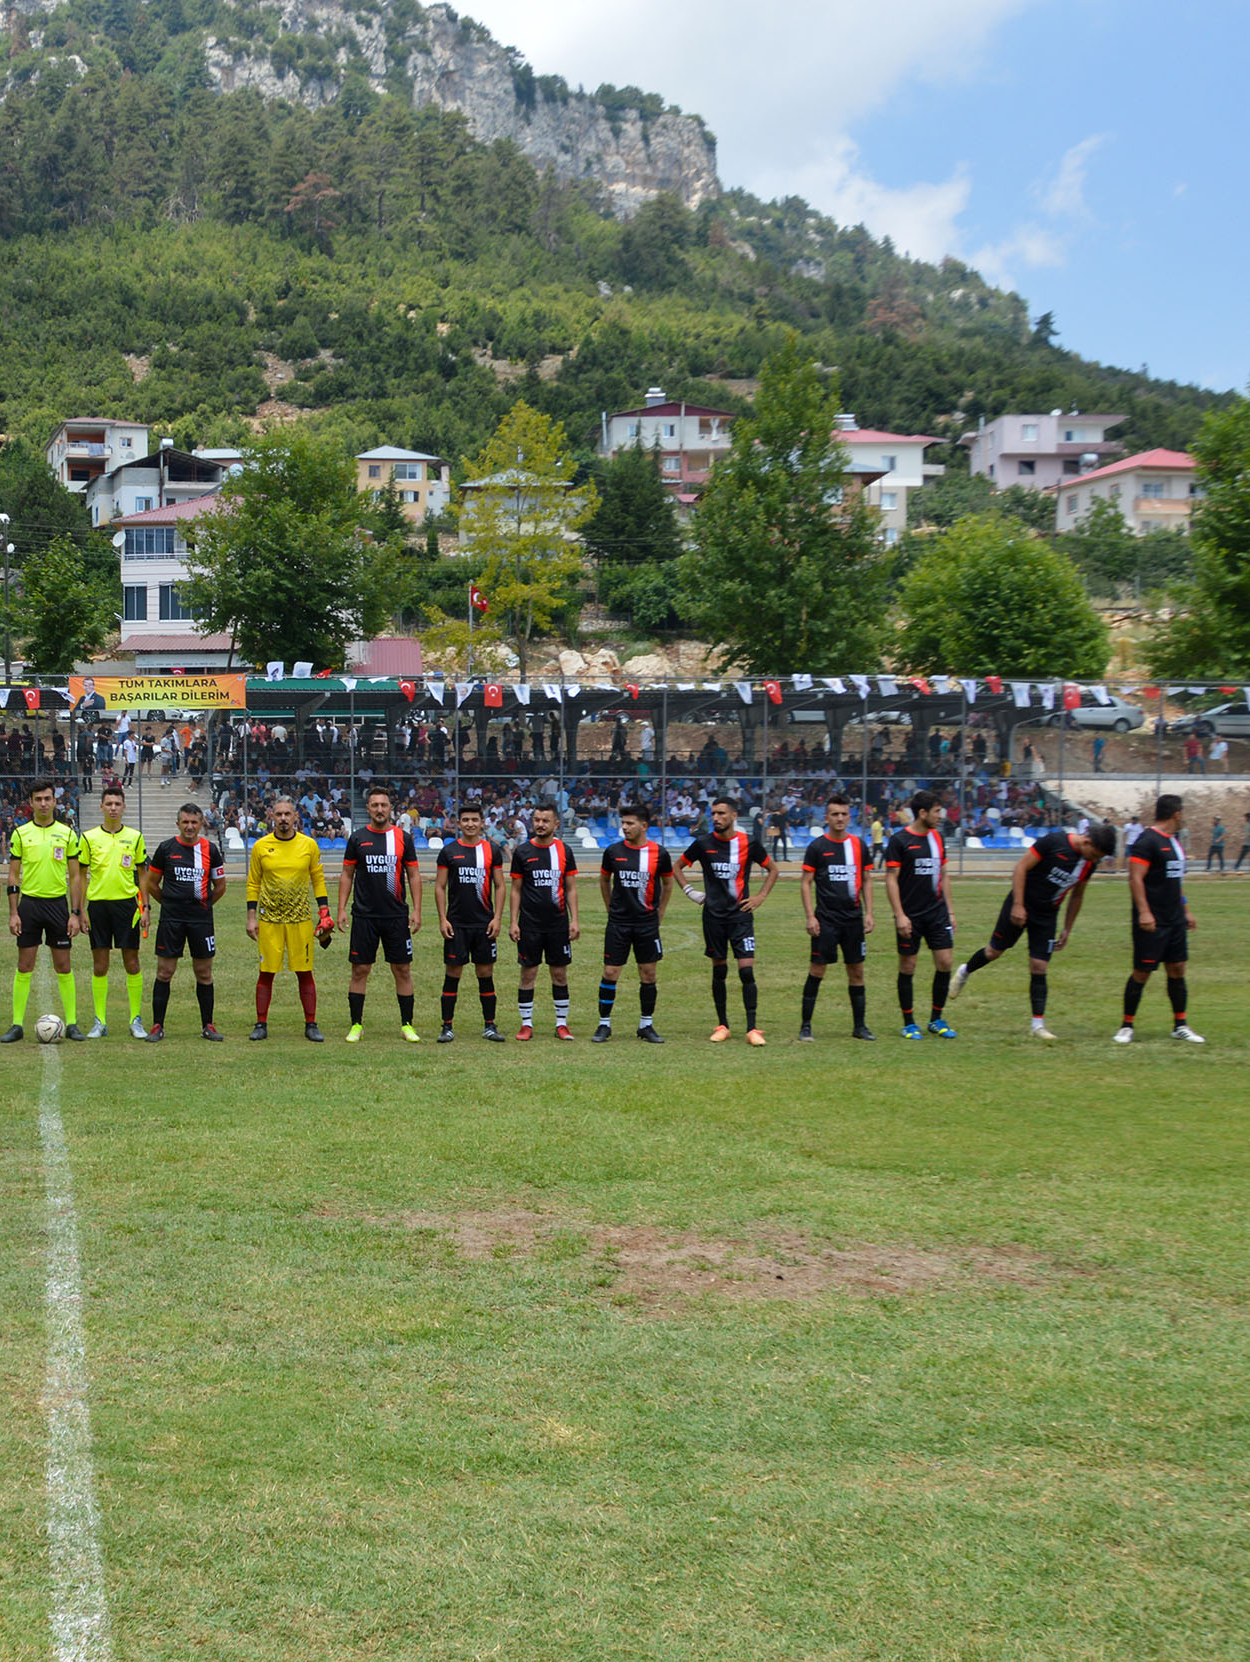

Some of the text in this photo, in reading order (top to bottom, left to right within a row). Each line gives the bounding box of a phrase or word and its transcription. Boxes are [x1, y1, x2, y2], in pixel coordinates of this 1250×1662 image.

[118, 678, 218, 689] TÜM TAKIMLARA
[110, 689, 230, 704] BAŞARILAR DİLERİM
[365, 854, 398, 865] UYGUN
[366, 864, 397, 873] TİCARET
[458, 866, 487, 877] UYGUN
[532, 869, 562, 879] UYGUN
[618, 869, 650, 880] UYGUN
[563, 945, 572, 959] 4
